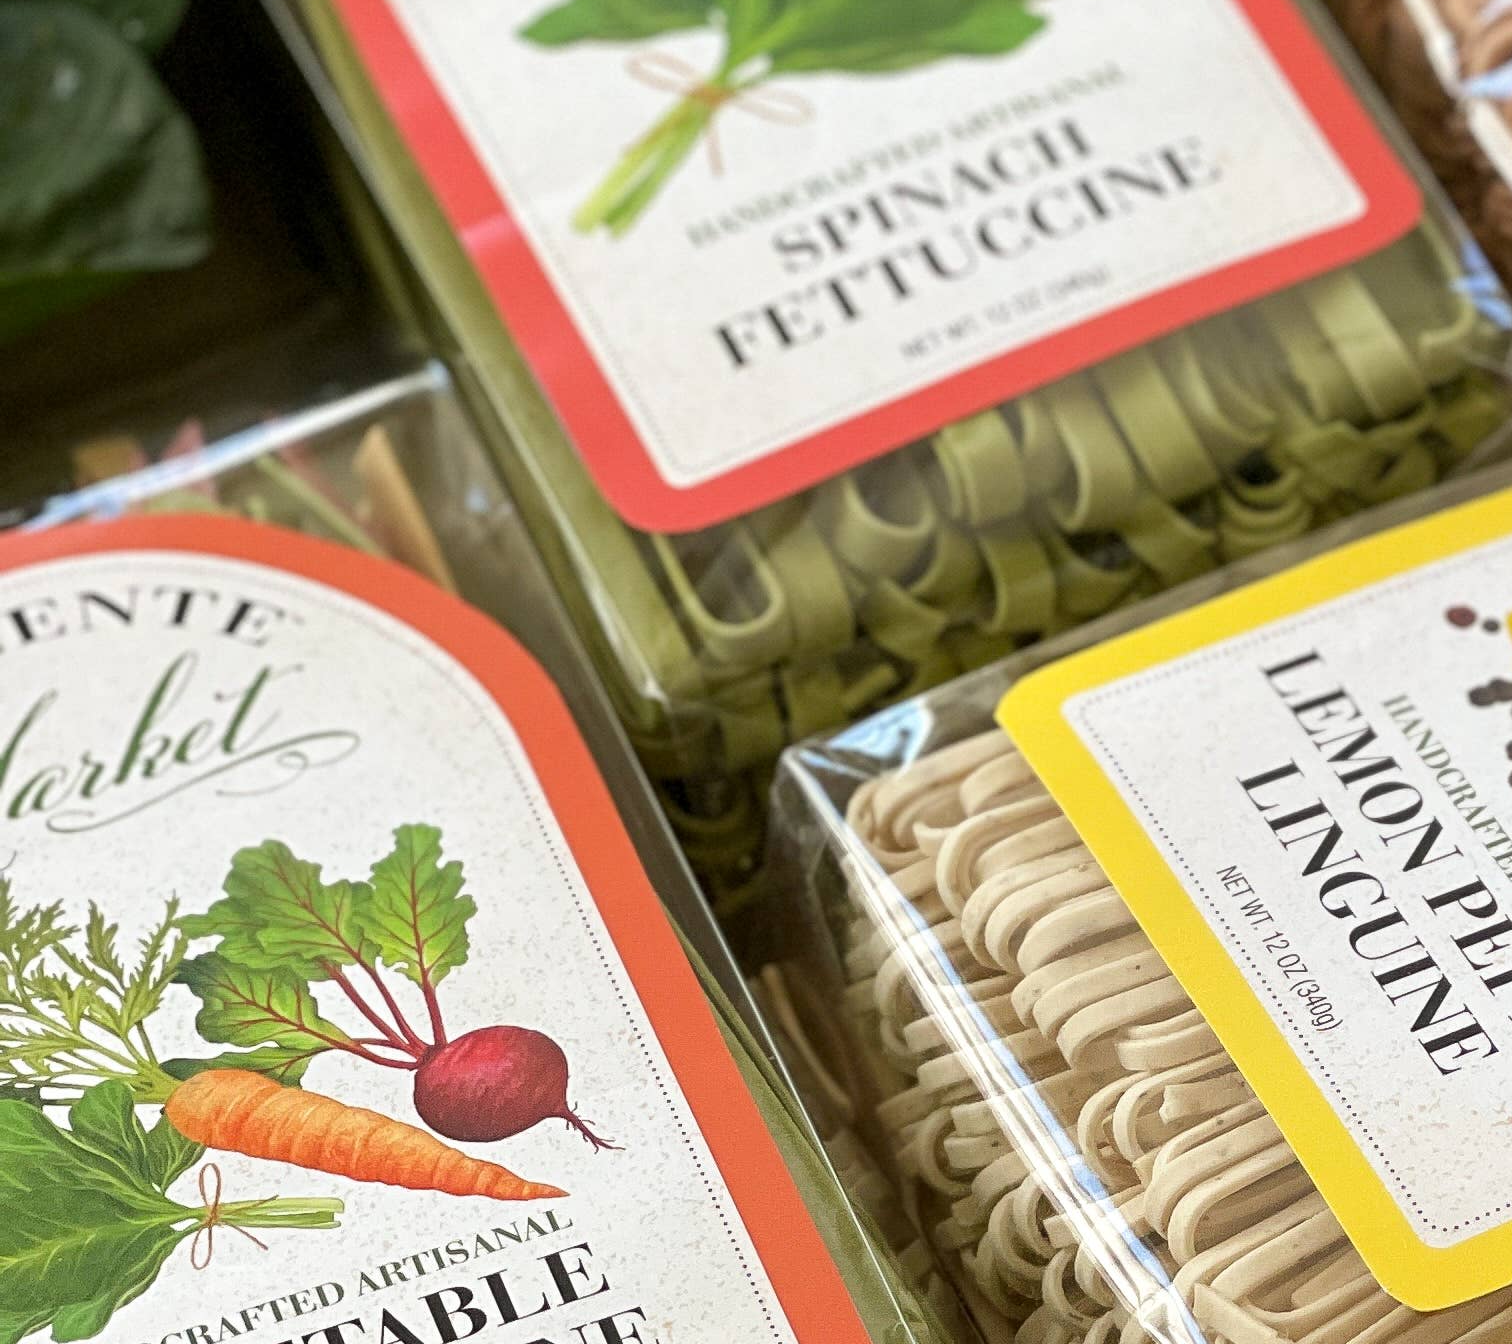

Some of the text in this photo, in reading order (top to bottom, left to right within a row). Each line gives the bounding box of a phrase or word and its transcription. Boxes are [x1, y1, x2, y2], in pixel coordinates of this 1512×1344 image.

[713, 135, 1223, 370] FETTUCCINE
[770, 116, 1093, 274] SPINACH
[0, 585, 288, 648] ENTE
[1260, 650, 1465, 873] LEMON
[1216, 864, 1344, 1033] NET WT. 12 OZ (340g)
[1236, 757, 1500, 1077] LINGUINE
[356, 1207, 574, 1299] ARTISANAL
